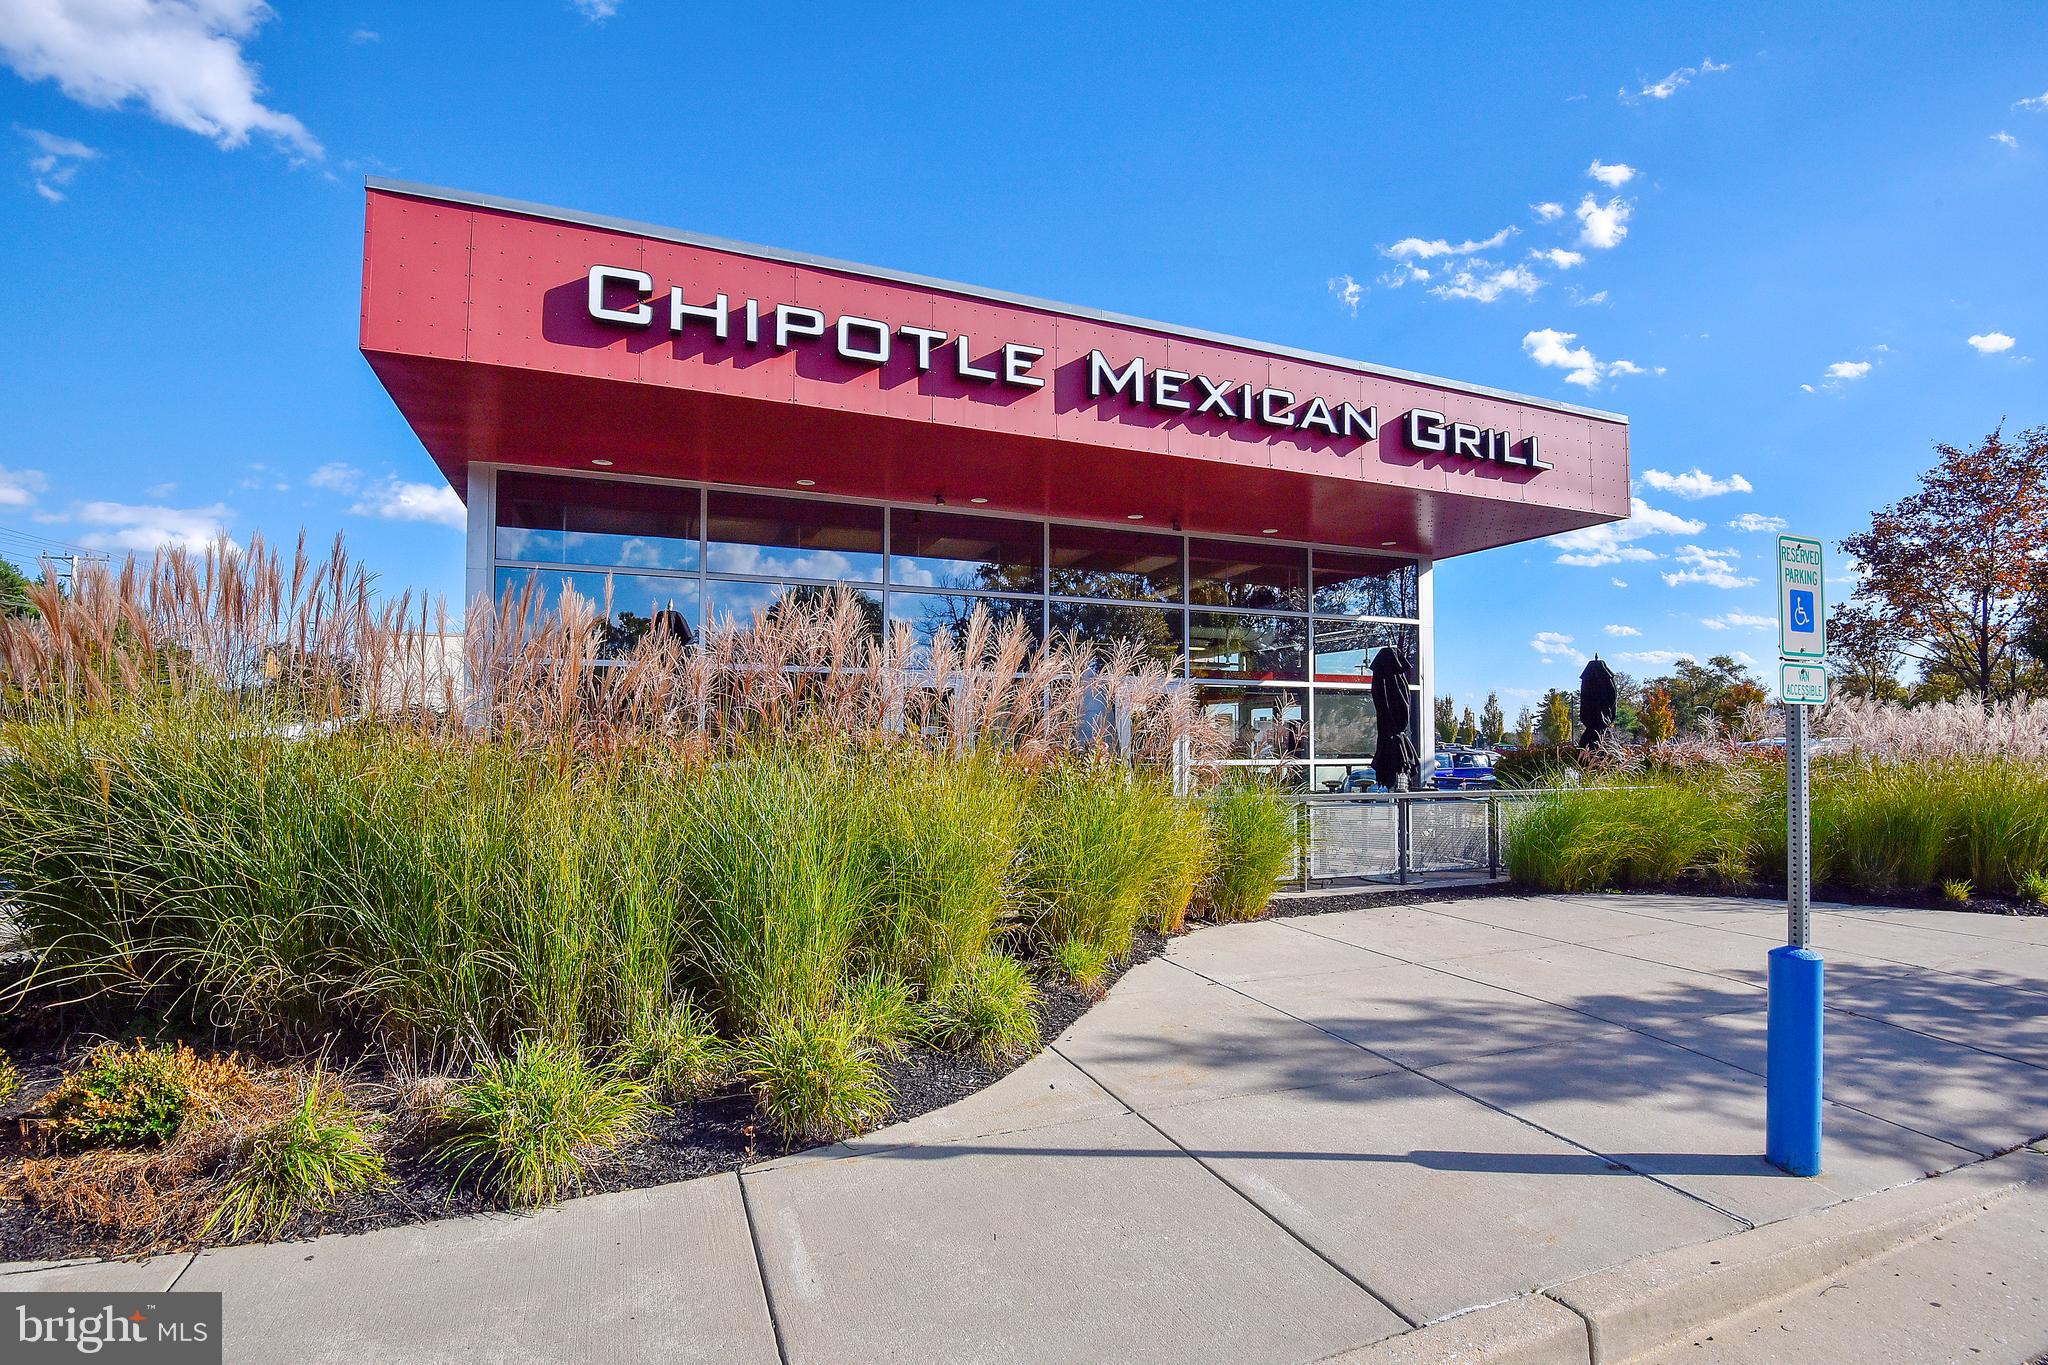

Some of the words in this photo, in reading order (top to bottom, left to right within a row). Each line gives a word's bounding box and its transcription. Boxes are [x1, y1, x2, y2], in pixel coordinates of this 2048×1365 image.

[587, 264, 1046, 388] CHIPOTLE
[1085, 348, 1378, 440] MEXICAN
[1402, 407, 1555, 470] GRILL
[1781, 546, 1820, 566] RESERVED
[1784, 567, 1818, 586] PARKING
[1786, 683, 1823, 697] ACCESSIBLE
